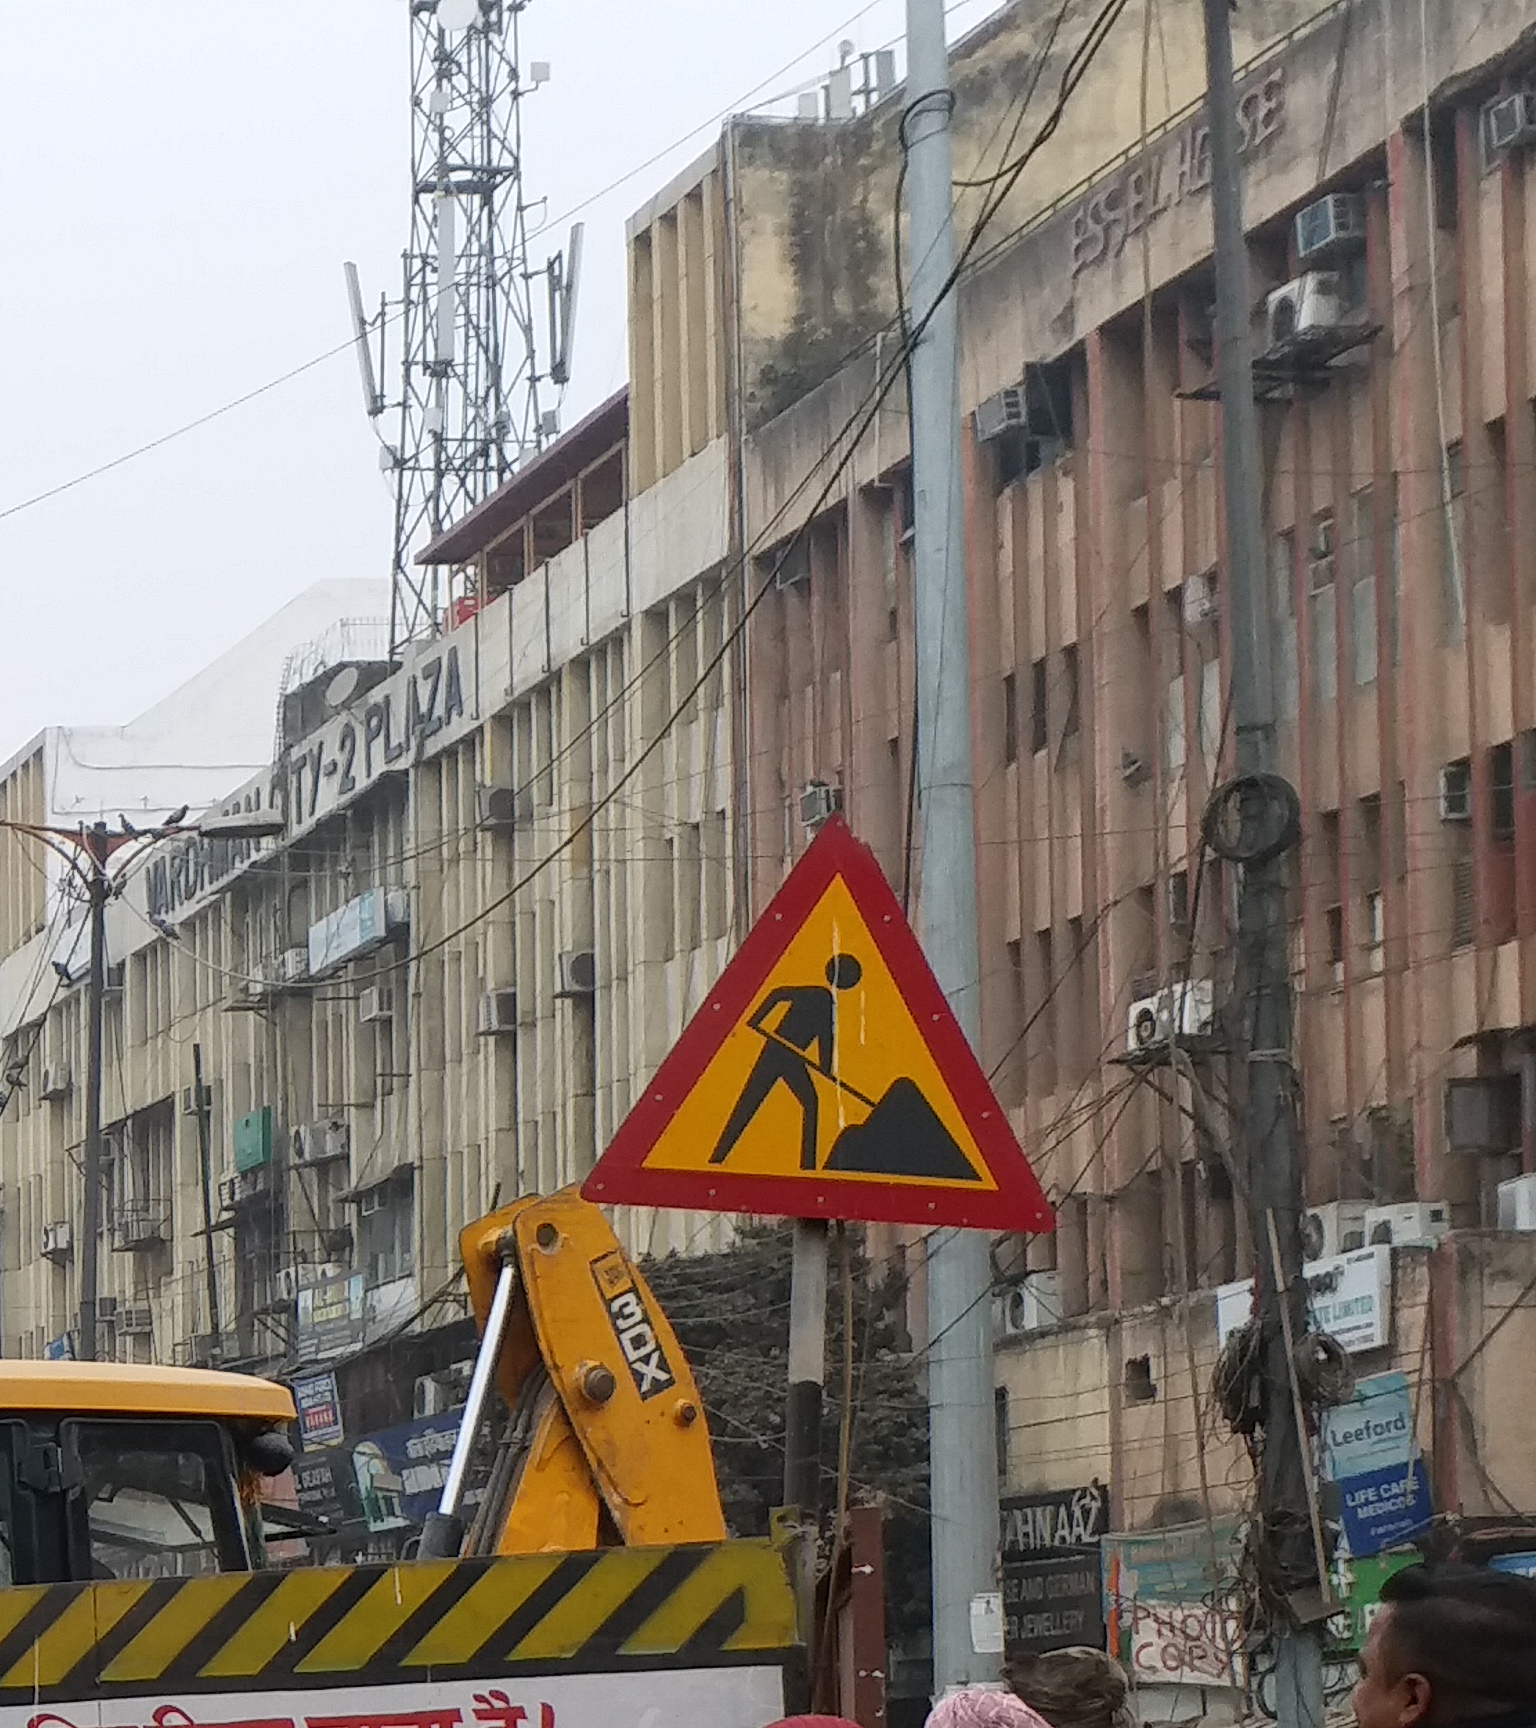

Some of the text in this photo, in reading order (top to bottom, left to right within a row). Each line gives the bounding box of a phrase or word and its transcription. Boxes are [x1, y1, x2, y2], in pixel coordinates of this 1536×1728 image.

[1178, 67, 1285, 200] HSE
[364, 645, 464, 778] PLAZA
[611, 1292, 671, 1394] 3DX
[1331, 1411, 1407, 1448] Leeford
[1000, 1500, 1100, 1552] AHNAAZ
[1345, 1481, 1377, 1508] LIFE
